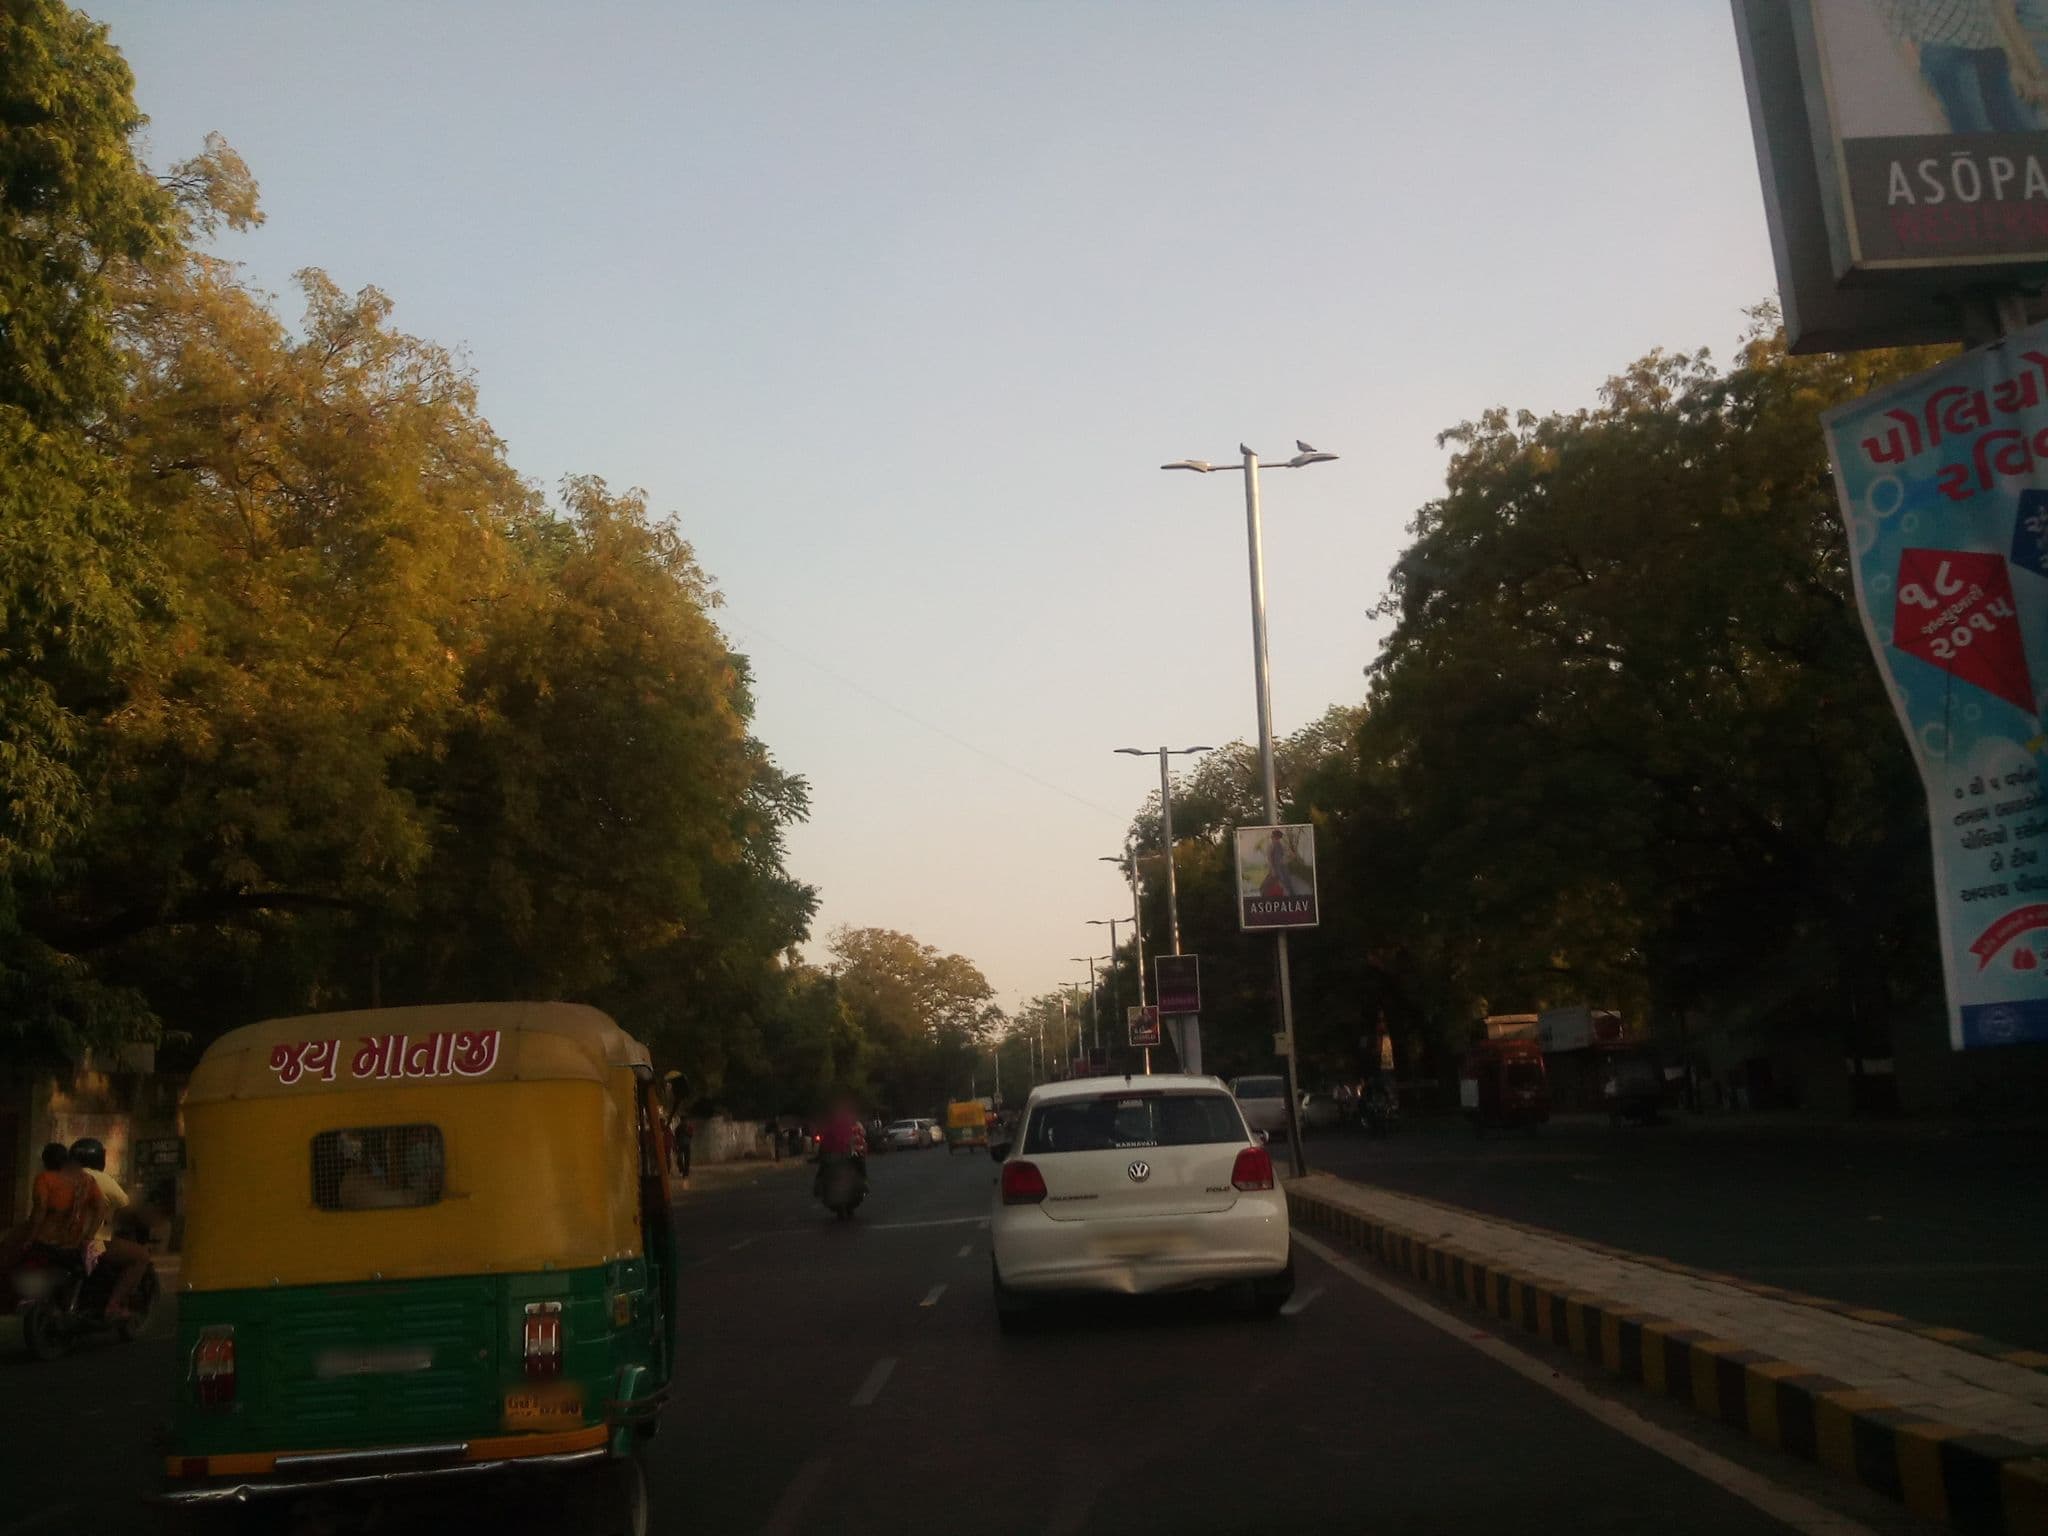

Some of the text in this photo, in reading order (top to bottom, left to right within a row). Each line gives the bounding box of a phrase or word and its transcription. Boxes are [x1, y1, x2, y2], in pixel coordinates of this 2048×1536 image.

[1929, 597, 2015, 659] ૨૦૧૫
[1251, 901, 1309, 913] ASOPALAV
[269, 1031, 501, 1085] જય માતાજી
